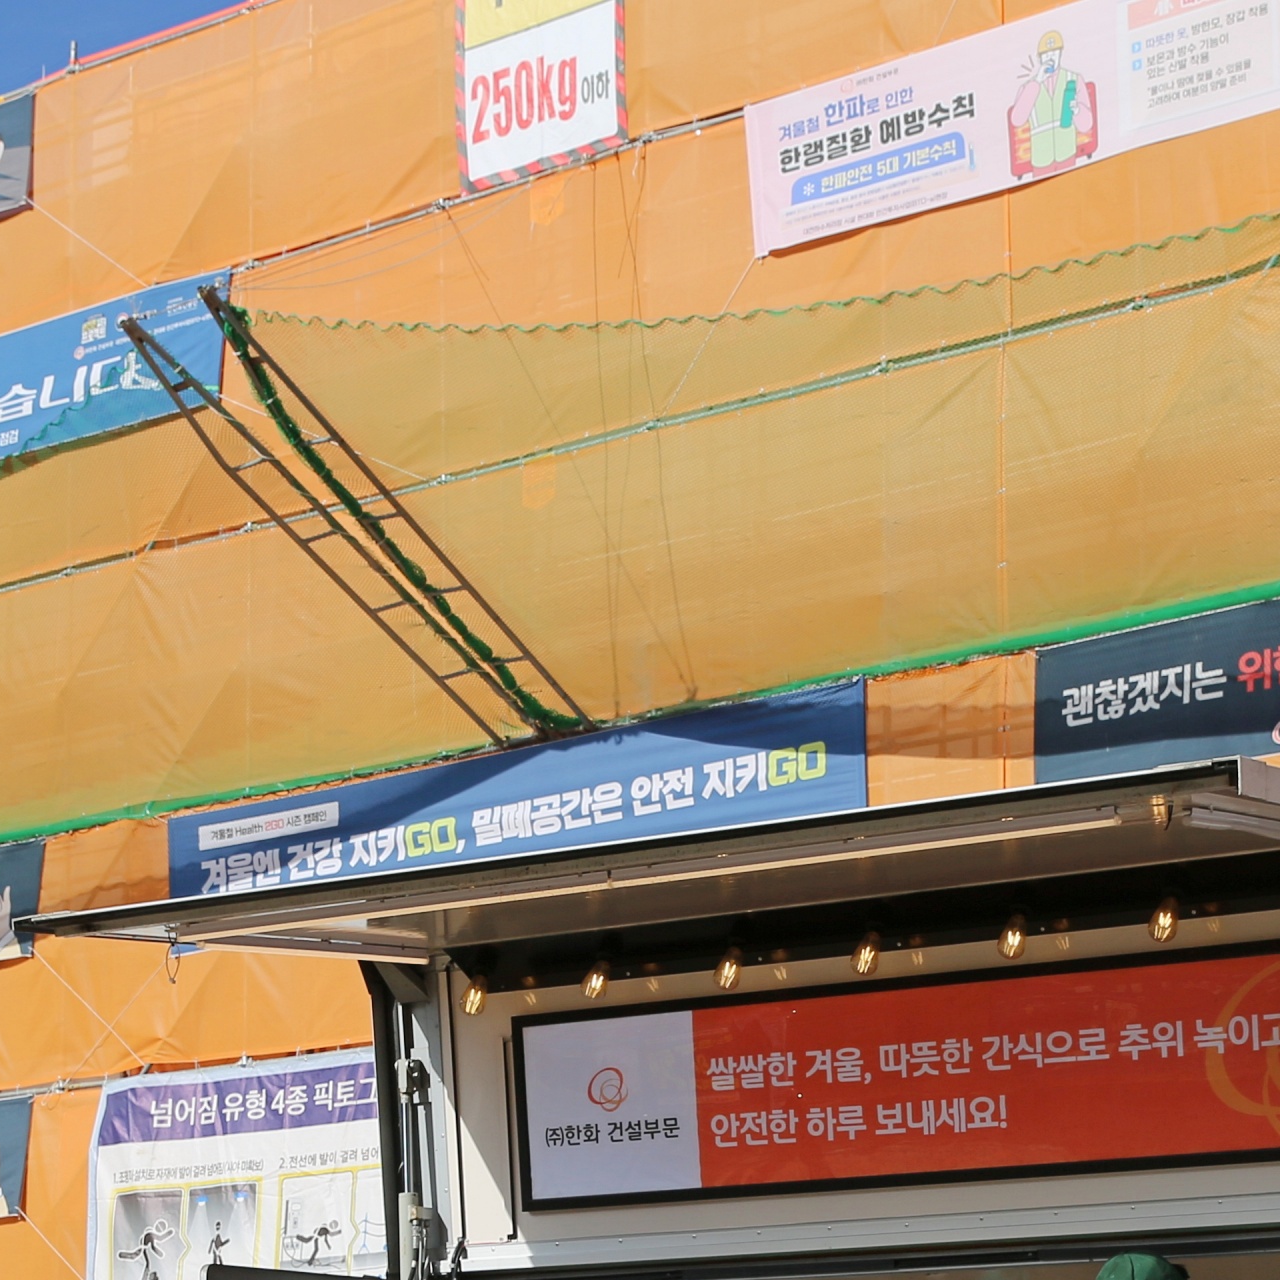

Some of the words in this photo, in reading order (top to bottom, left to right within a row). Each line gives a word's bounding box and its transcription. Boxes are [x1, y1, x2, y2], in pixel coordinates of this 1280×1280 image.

[471, 55, 577, 145] 250kg
[581, 70, 610, 104] 이하
[779, 114, 820, 142] 겨울철
[824, 93, 880, 127] 한파로
[885, 86, 914, 109] 인한
[780, 124, 872, 174] 한랭질환
[879, 92, 976, 145] 예방수칙
[876, 156, 899, 177] 5대
[903, 140, 957, 170] 기본수칙
[0, 428, 19, 448] 점검
[1060, 659, 1228, 728] 괜찮겠지는
[201, 849, 281, 895] 겨울엔
[287, 838, 343, 881] 건강
[349, 815, 466, 870] 지키GO,
[471, 783, 624, 849] 밀폐공간은
[629, 769, 695, 815] 안전
[700, 741, 828, 799] 지키GO
[235, 823, 264, 837] Health
[264, 818, 284, 832] 2GO
[286, 815, 302, 828] 시즌
[706, 1048, 798, 1093] 쌀쌀한
[804, 1044, 873, 1087] 겨울,
[878, 1038, 973, 1079] 따뜻한
[980, 1026, 1106, 1071] 간식으로
[1117, 1021, 1185, 1064] 추위
[150, 1094, 218, 1129] 넘어짐
[222, 1088, 267, 1120] 유형
[272, 1084, 309, 1116] 4종
[606, 1116, 681, 1143] 건설부문
[708, 1106, 800, 1149] 안전한
[805, 1103, 869, 1142] 하루
[875, 1093, 1010, 1136] 보내세요!
[319, 1150, 337, 1166] 발이
[340, 1148, 358, 1163] 걸려
